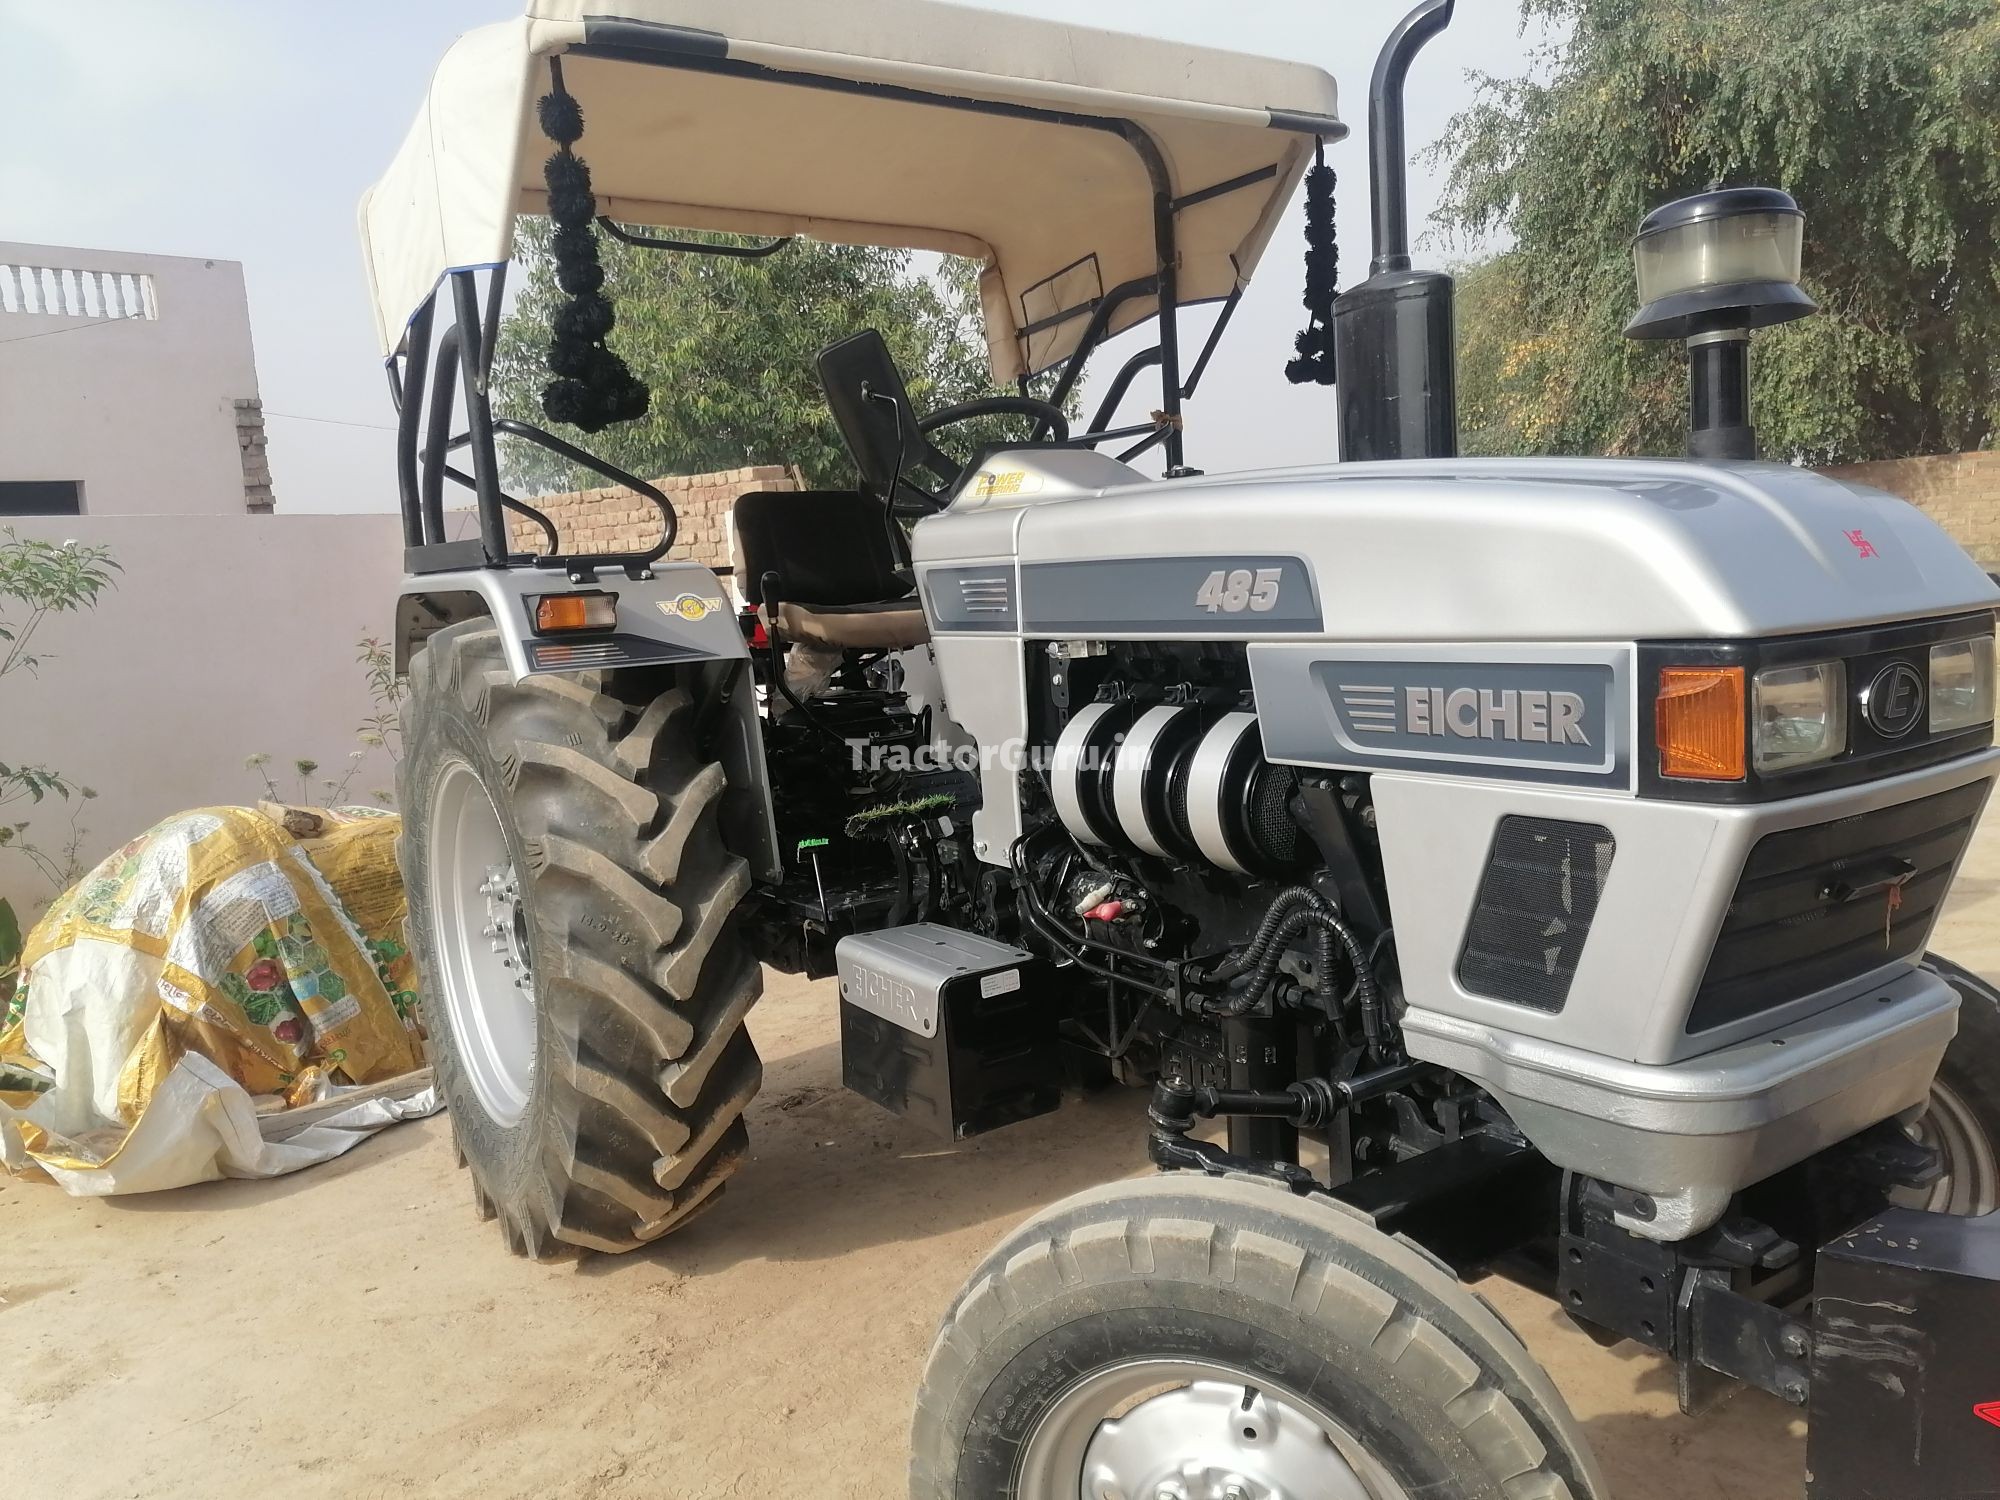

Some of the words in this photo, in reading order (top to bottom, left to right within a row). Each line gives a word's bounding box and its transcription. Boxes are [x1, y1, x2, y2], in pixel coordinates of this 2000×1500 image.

[1195, 567, 1283, 614] 485
[1405, 686, 1592, 747] EICHER
[852, 963, 918, 1021] EICHER
